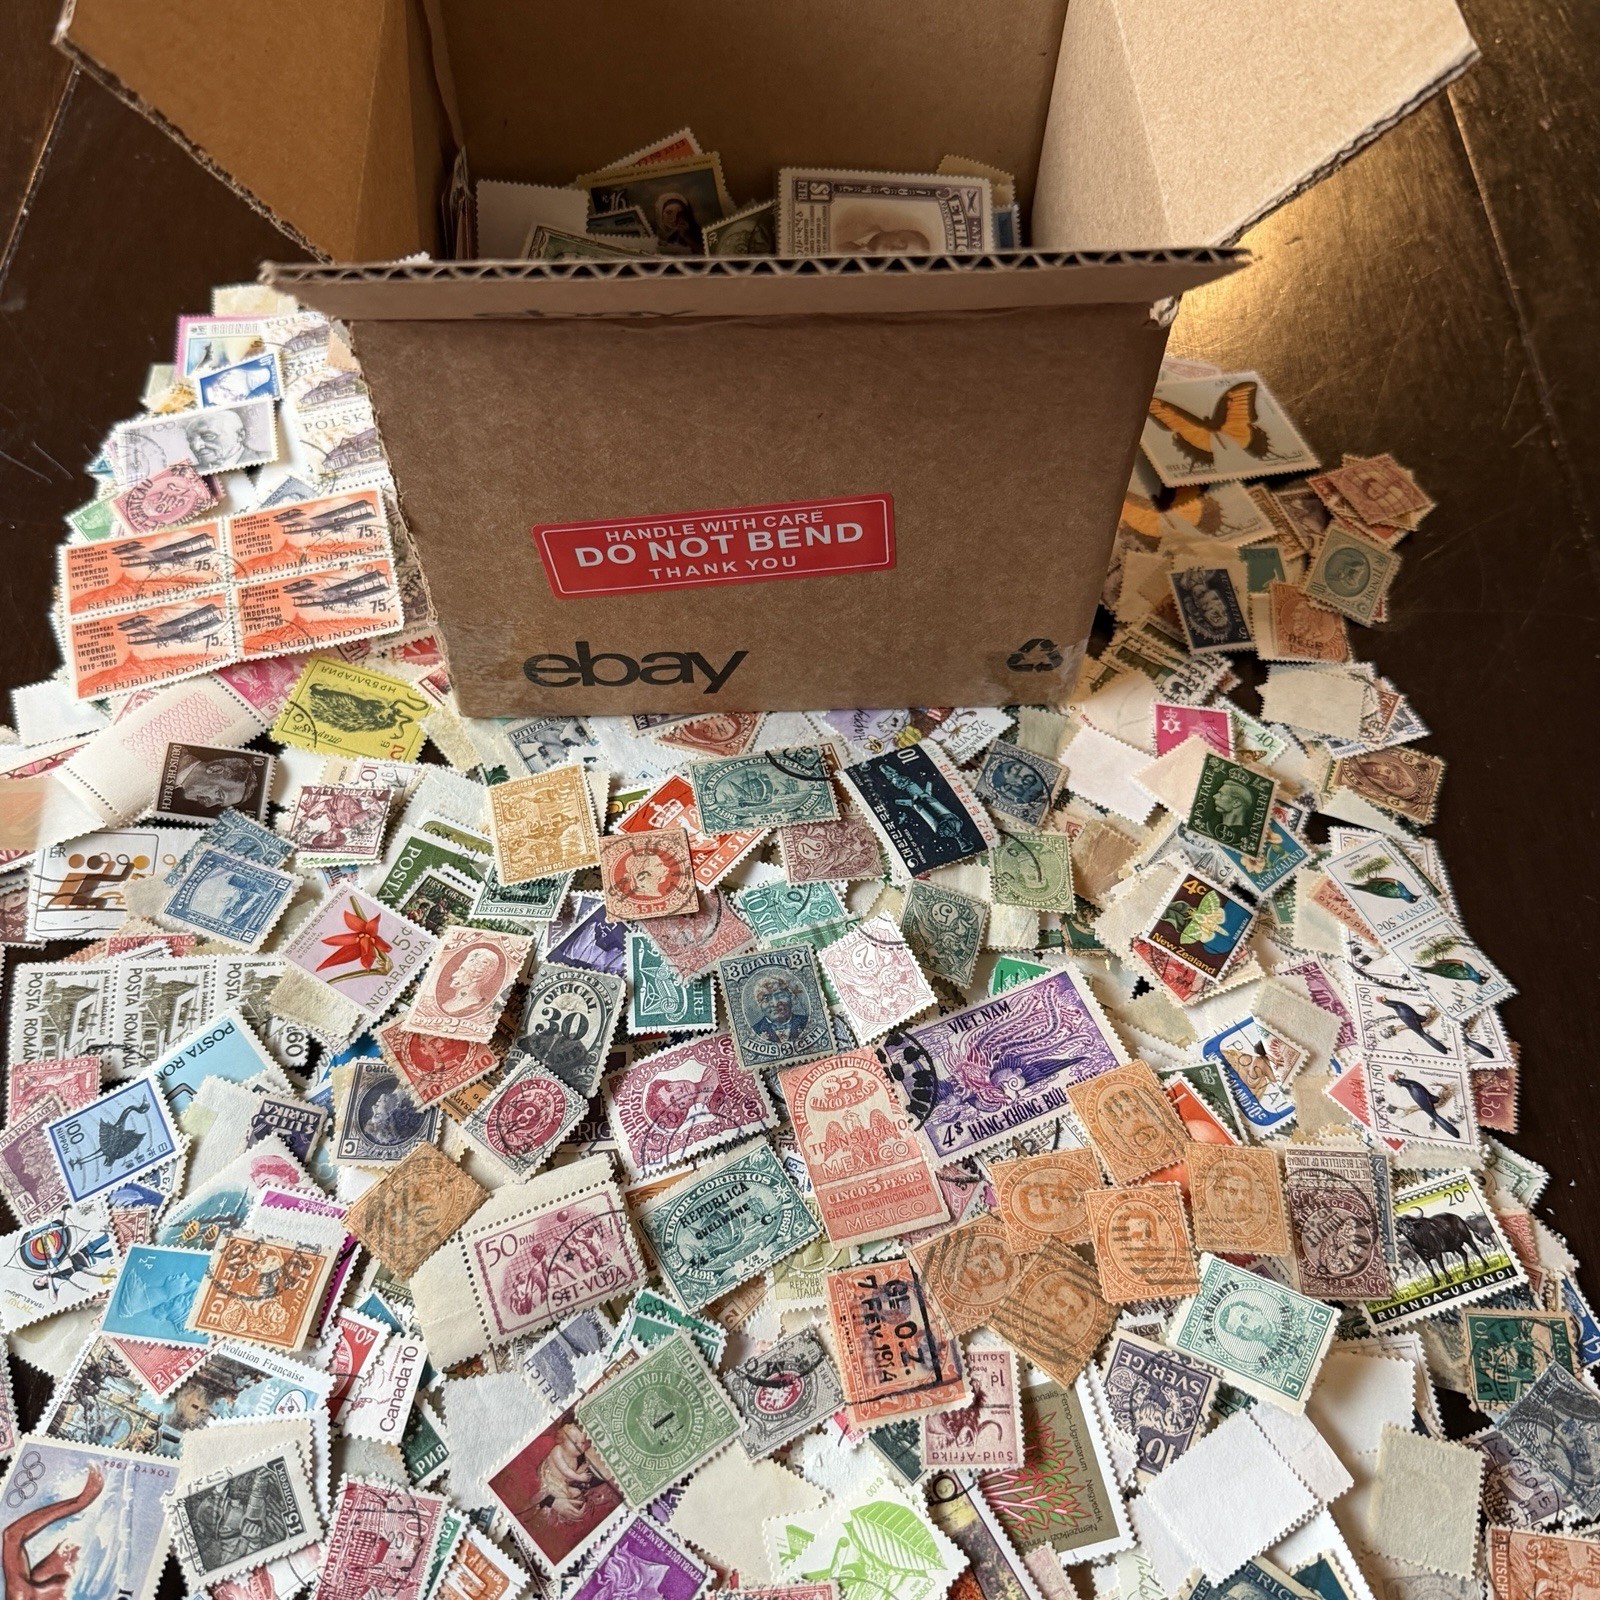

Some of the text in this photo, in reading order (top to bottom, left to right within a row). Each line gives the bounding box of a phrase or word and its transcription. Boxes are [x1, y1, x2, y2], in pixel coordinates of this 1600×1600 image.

[605, 510, 825, 543] HANDLE WITH CARE
[252, 545, 385, 576] REPUBLIK INDONESIA
[574, 521, 864, 568] DO NOT BEND
[649, 555, 797, 580] THANK YOU
[87, 576, 223, 610] REPUBLIK INDONESIA
[262, 619, 400, 652] REPUBLIK INDONESIA
[95, 653, 232, 693] REPUBLIK INDONESIA
[523, 640, 750, 695] ebay
[854, 708, 871, 742] Happy
[896, 748, 920, 765] 10
[161, 744, 182, 811] DEUTSCHES REICH
[311, 787, 385, 796] AUSTRALIA
[706, 761, 745, 791] AFRICA
[1196, 768, 1214, 818] POSTAGE
[1249, 789, 1268, 845] REVENUE
[379, 845, 422, 900] POSTA
[426, 878, 444, 892] FIRST
[1257, 849, 1305, 890] NEW ZEALAND
[1182, 879, 1208, 896] 4c
[285, 888, 348, 955] SOBRETASA POSTAL
[479, 905, 551, 917] DEUTSCHES REICH
[1401, 900, 1437, 922] KENYA
[1152, 932, 1217, 976] New Zealand
[366, 940, 431, 1011] NICARAGUA
[530, 973, 561, 995] POST
[543, 982, 598, 1014] OFFICIAL
[692, 976, 704, 1016] EIRE
[187, 1021, 236, 1057] POSTA
[534, 1006, 589, 1041] 30
[23, 1018, 39, 1065] ROMÂN
[286, 1031, 304, 1058] 60
[745, 1027, 827, 1056] TROIS CENT.
[20, 1061, 91, 1072] ONE PENNY
[821, 1070, 861, 1096] $5
[521, 1080, 563, 1121] DANMARK
[793, 1077, 811, 1126] EJERCITO
[810, 1080, 878, 1109] CINCO PESOS
[15, 1105, 54, 1135] POSTAGE
[264, 1101, 320, 1123] AFRIKA
[515, 1106, 536, 1123] 8
[55, 1128, 70, 1154] NIPPON
[65, 1119, 85, 1145] 100
[809, 1118, 908, 1156] TRANSITORIO
[821, 1141, 910, 1179] MEXICO
[827, 1169, 924, 1205] CINCO 5 PESOS
[827, 1184, 932, 1221] EJERCITO CONSTITUCIONALISTA
[298, 1200, 335, 1214] CORREOS
[665, 1172, 772, 1244] TIMOR CORREIOS
[680, 1181, 751, 1229] REPUBLICA
[845, 1200, 927, 1233] MEXICO
[777, 1209, 793, 1238] 1898
[484, 1232, 537, 1268] 50 DIN
[1103, 1255, 1165, 1297] CENTESIMI
[22, 1296, 46, 1309] ISRAEL
[1377, 1268, 1515, 1324] RUANDA-URUNDI
[857, 1274, 899, 1384] 7 1914
[1315, 1312, 1328, 1322] 5
[355, 1328, 376, 1345] 40
[262, 1357, 305, 1382] Française
[968, 1352, 1006, 1364] South
[1119, 1350, 1204, 1395] SVERIGE
[380, 1346, 419, 1432] Canada 10
[637, 1372, 672, 1388] INDIA
[680, 1350, 727, 1423] CORREIO
[990, 1371, 1006, 1388] 1d
[1285, 1382, 1300, 1392] 5
[1060, 1392, 1088, 1472] Fenno-Ugristarum
[103, 1460, 171, 1478] TOKYO 1964
[603, 1444, 636, 1491] REIS
[931, 1450, 1014, 1462] Suid-Afrika
[1086, 1479, 1104, 1523] Negyedik
[283, 1512, 301, 1538] 15
[333, 1500, 352, 1563] DEUTSCHE
